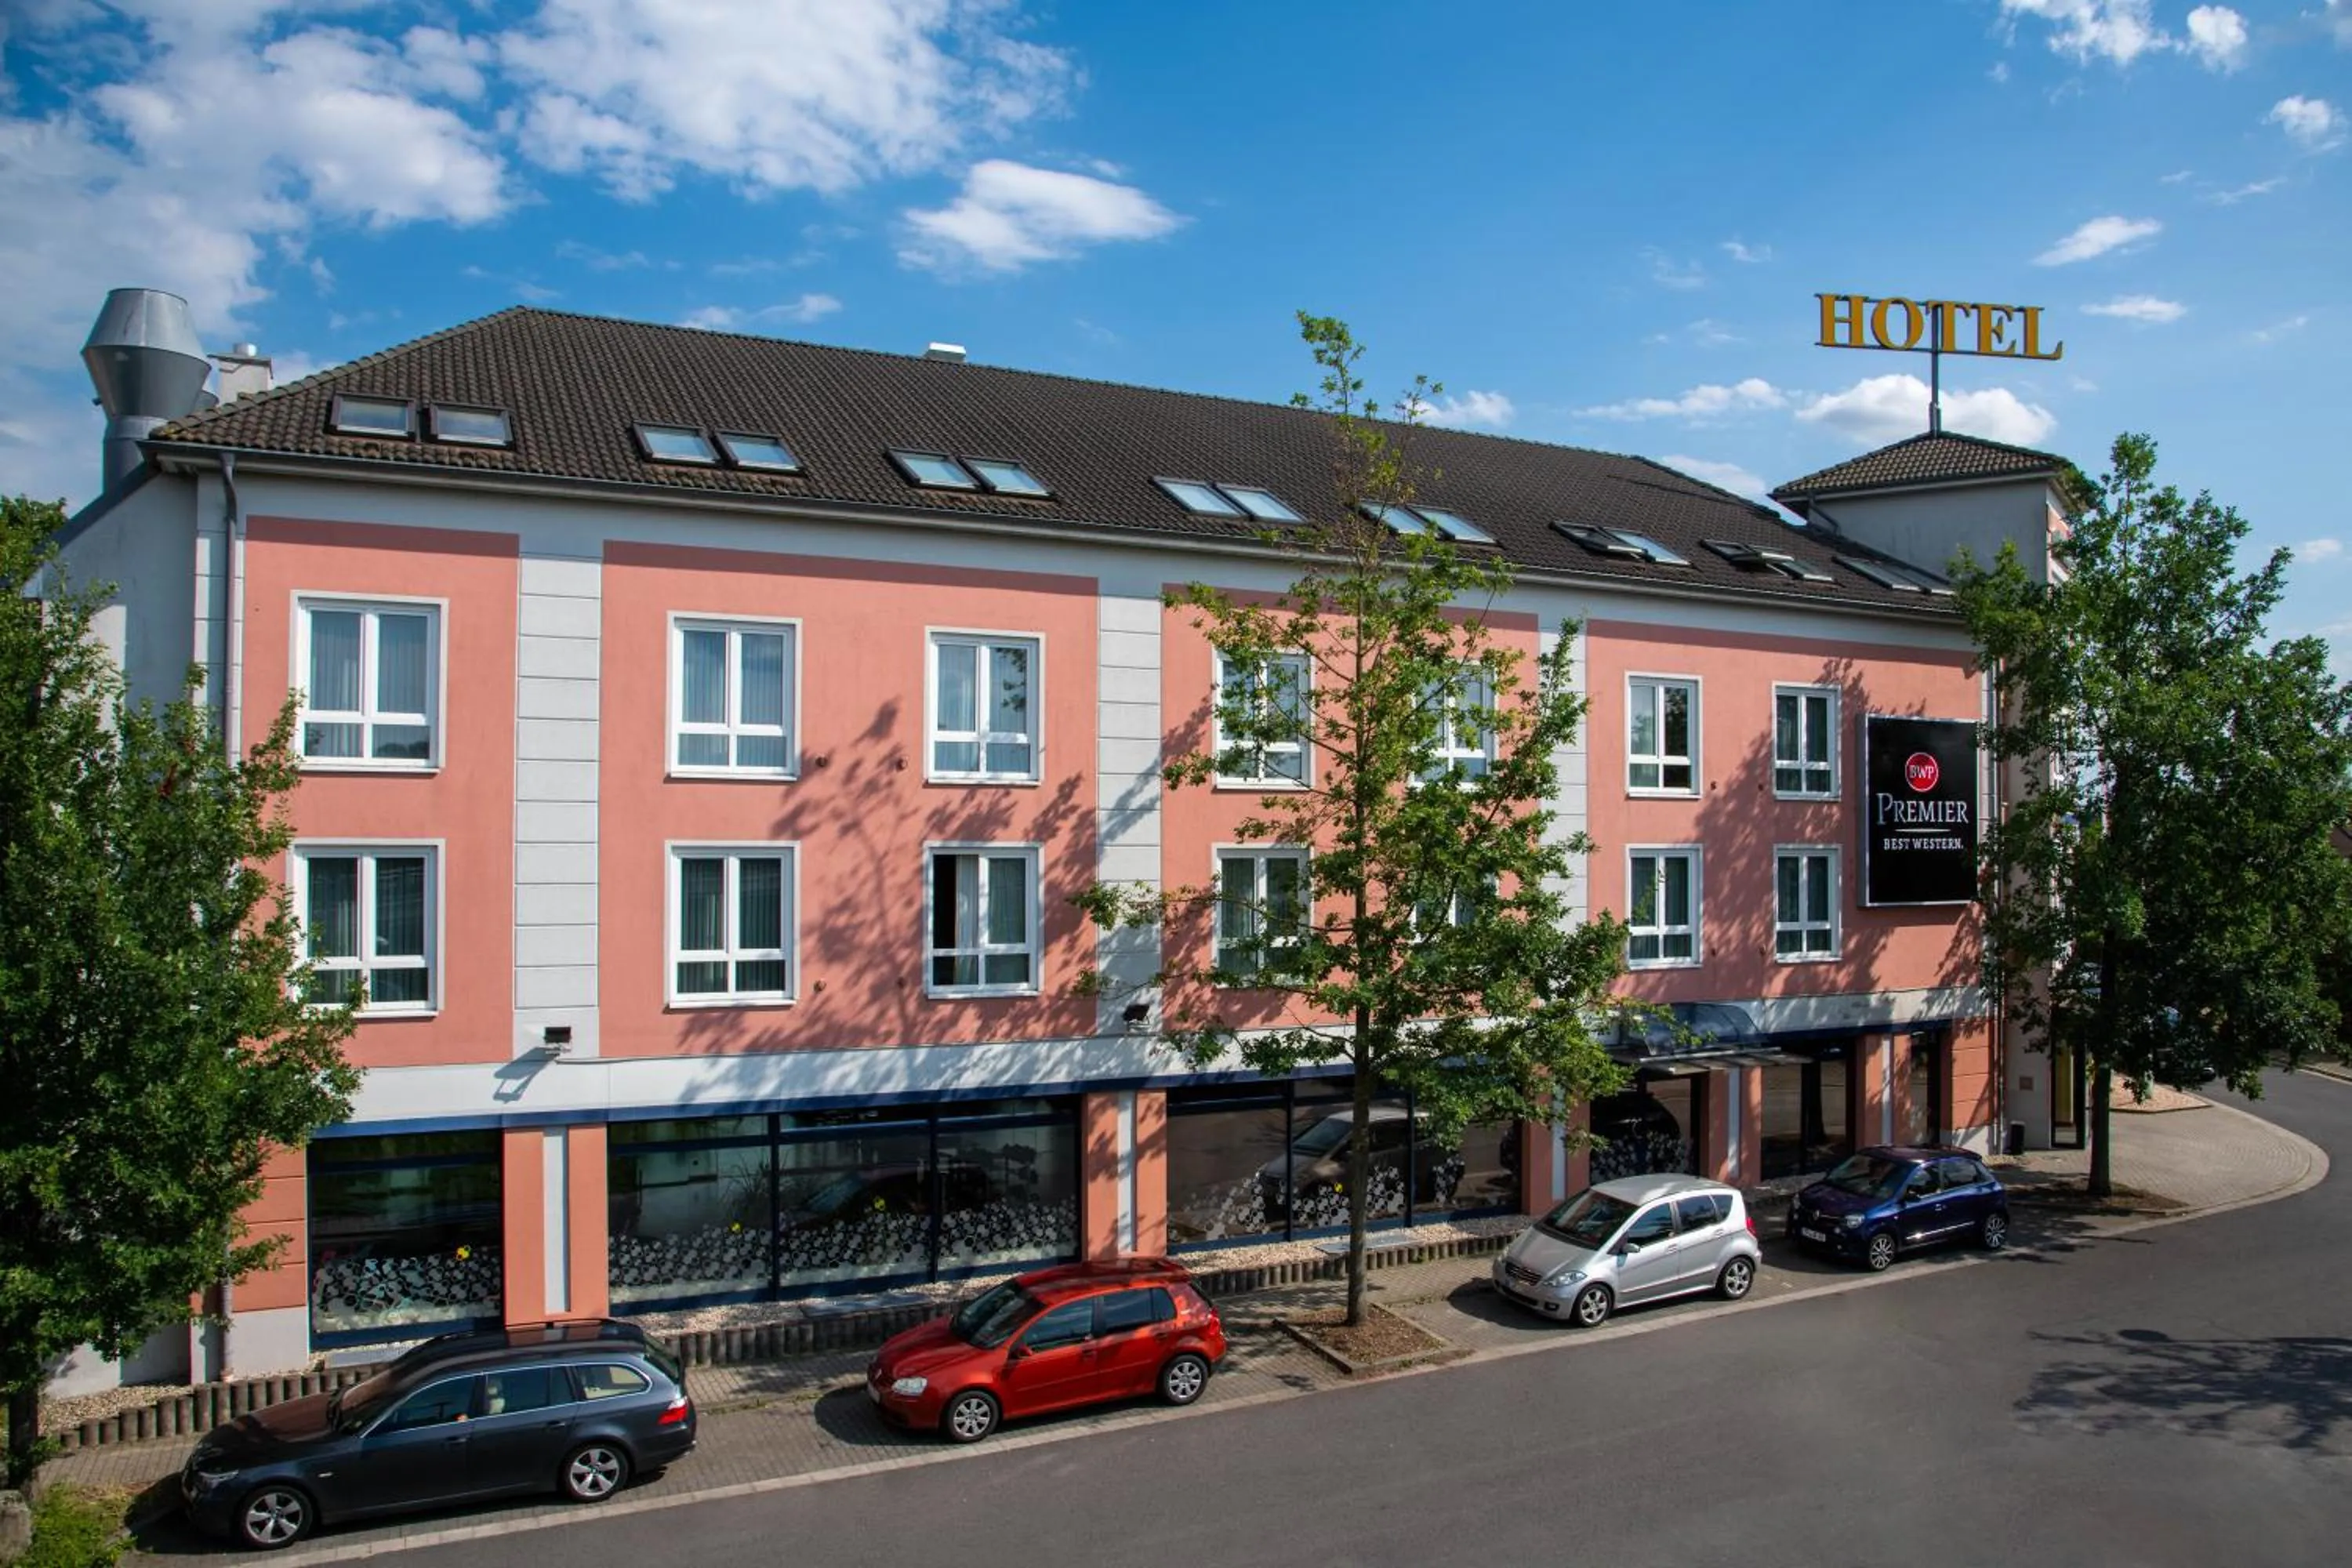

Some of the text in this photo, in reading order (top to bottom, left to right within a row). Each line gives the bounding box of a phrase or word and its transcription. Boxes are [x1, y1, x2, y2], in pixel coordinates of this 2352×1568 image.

[1815, 293, 2063, 360] HOTEL
[1909, 764, 1935, 779] BWP
[1883, 838, 1910, 851] BEST
